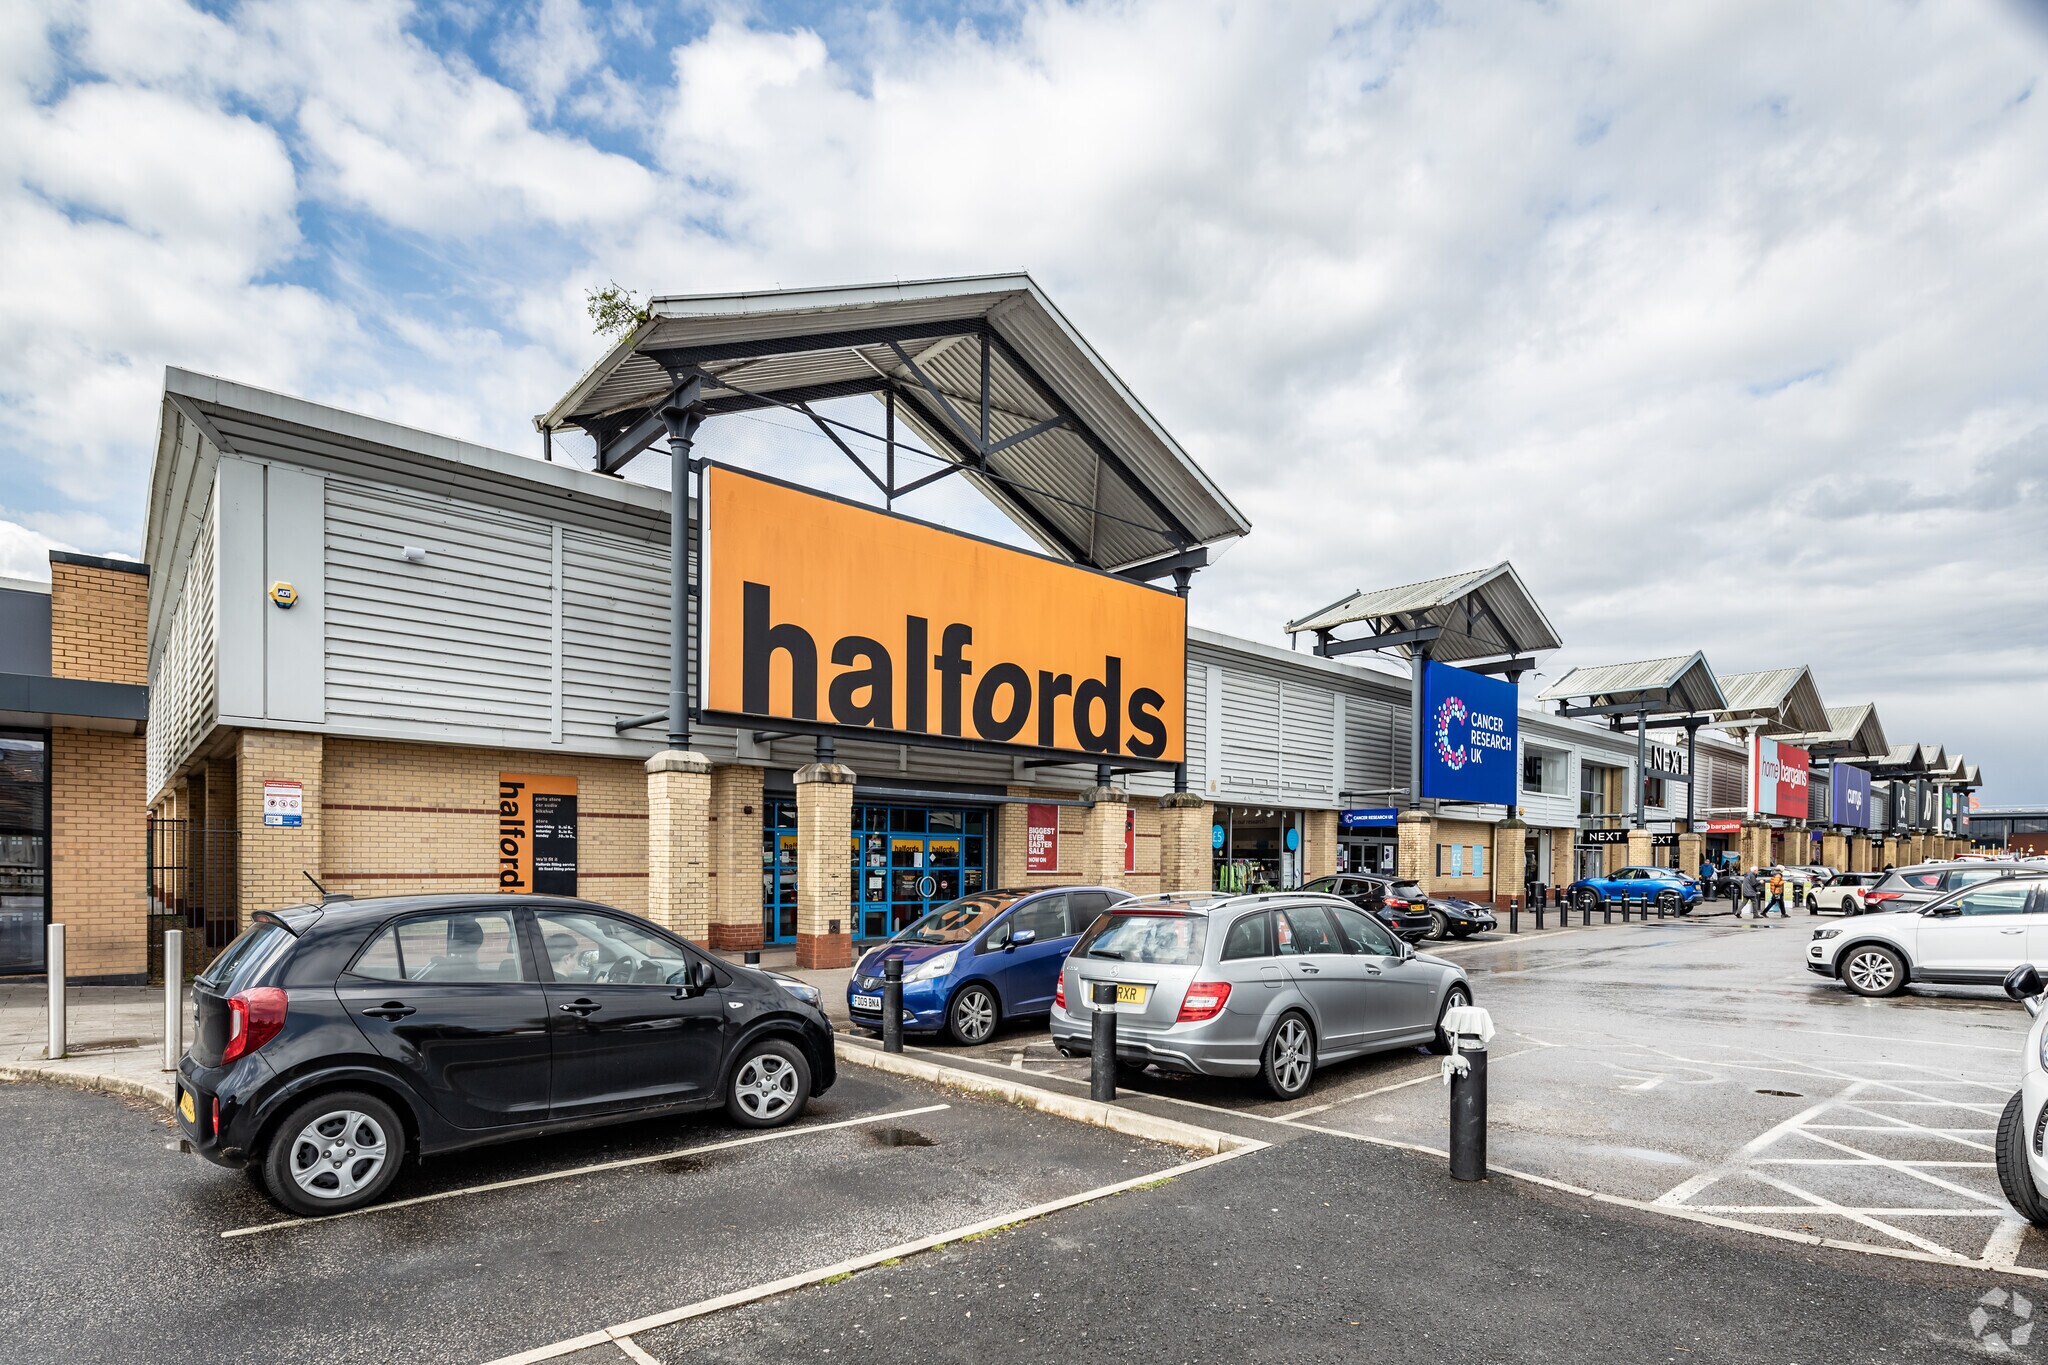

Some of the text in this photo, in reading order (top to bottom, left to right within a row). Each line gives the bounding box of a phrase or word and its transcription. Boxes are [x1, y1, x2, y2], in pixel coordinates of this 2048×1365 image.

[277, 589, 291, 597] ADT
[743, 581, 1167, 759] halfords
[1471, 712, 1504, 733] CANCER
[1471, 730, 1512, 751] RESEARCH
[1471, 748, 1482, 764] UK
[1652, 745, 1688, 774] NEXT
[1762, 756, 1807, 789] home bargains
[1847, 788, 1862, 811] currys
[1212, 831, 1222, 842] £5
[1589, 832, 1622, 841] NEXT
[1652, 836, 1673, 844] EXT
[1117, 986, 1137, 1000] RXR
[854, 996, 880, 1007] FD09 BNA
